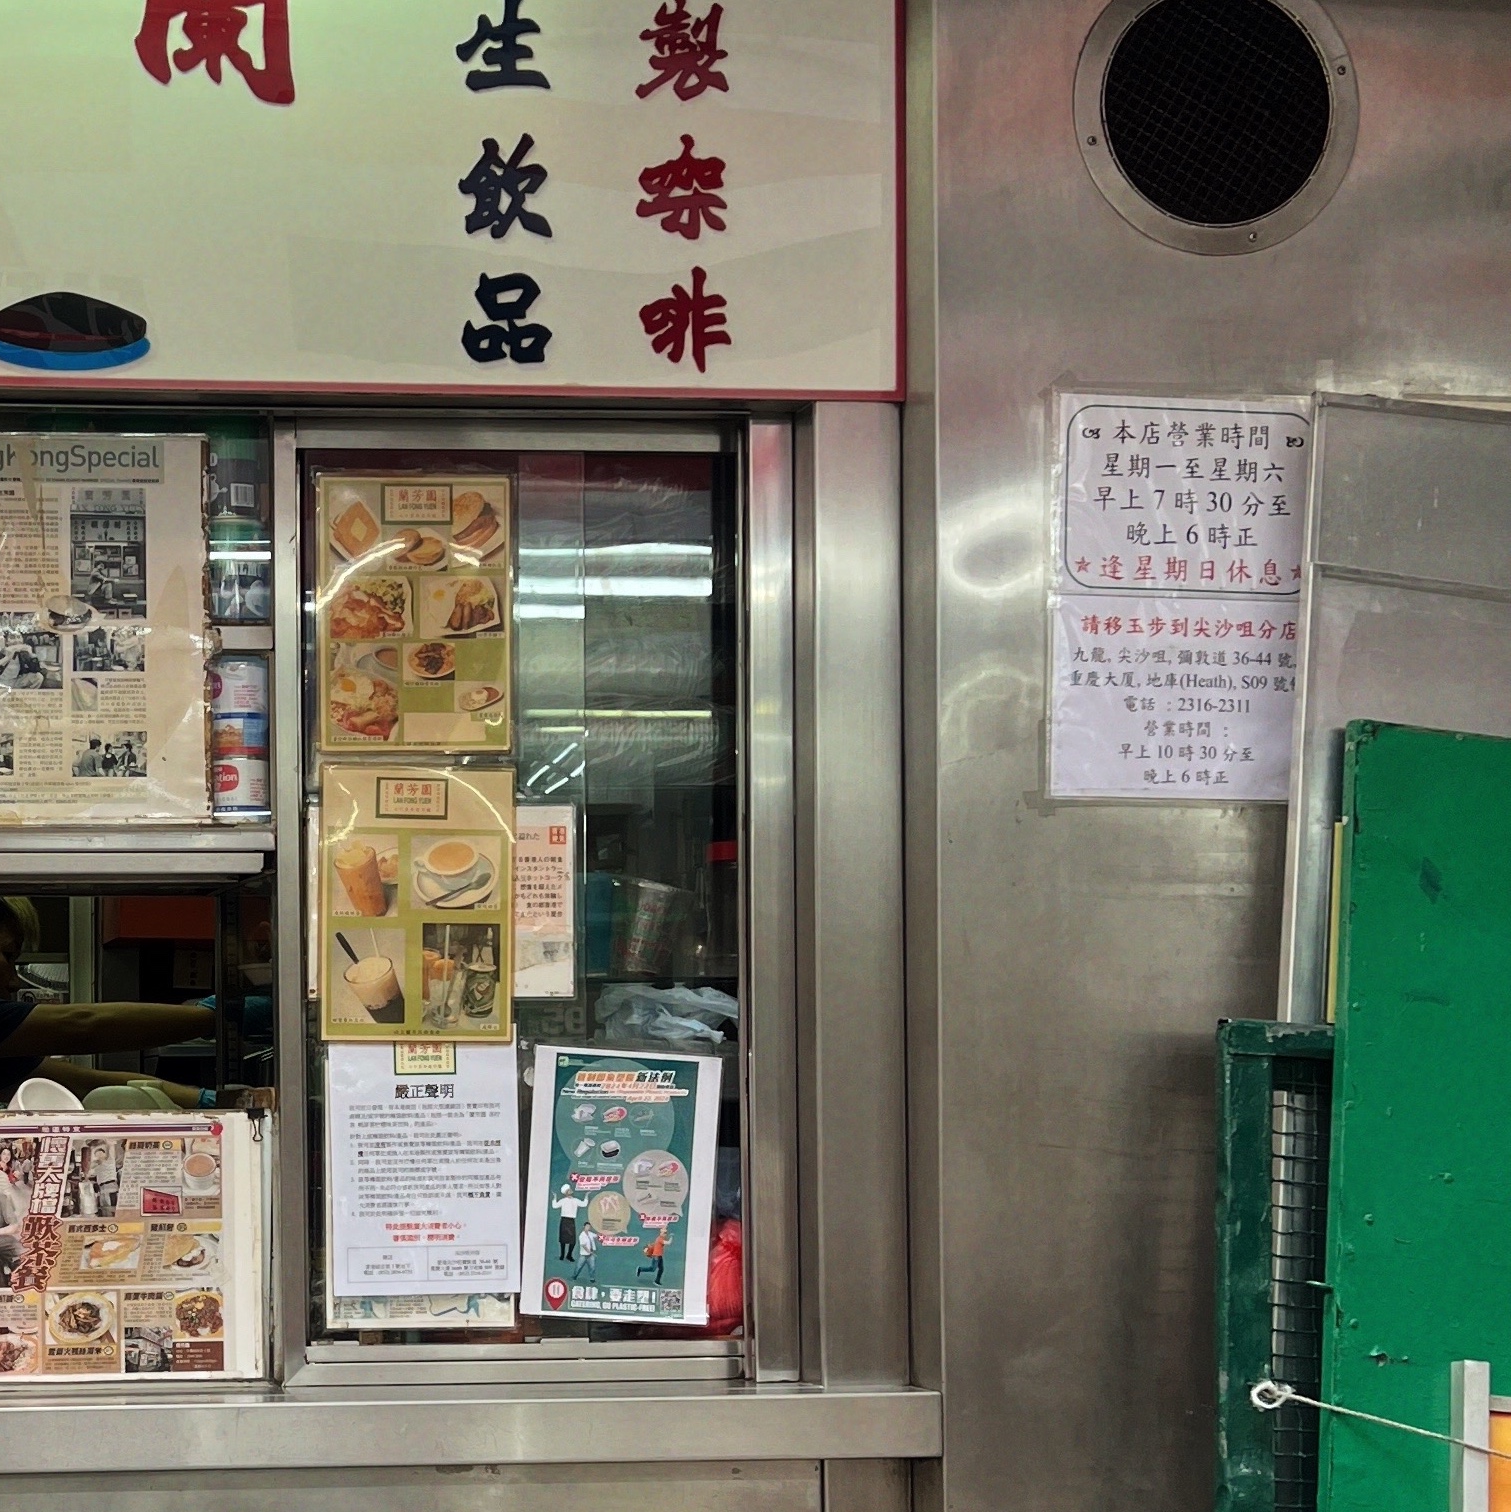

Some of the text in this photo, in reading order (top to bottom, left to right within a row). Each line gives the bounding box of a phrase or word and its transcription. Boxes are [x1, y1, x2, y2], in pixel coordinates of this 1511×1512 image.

[1112, 419, 1270, 450] 本店營業時間
[1100, 452, 1285, 484] 星期一至星期六
[1099, 554, 1282, 586] 逢星期日休息
[1080, 613, 1297, 641] 請移玉步到尖沙咀分店
[395, 1084, 454, 1099] 嚴正聲明
